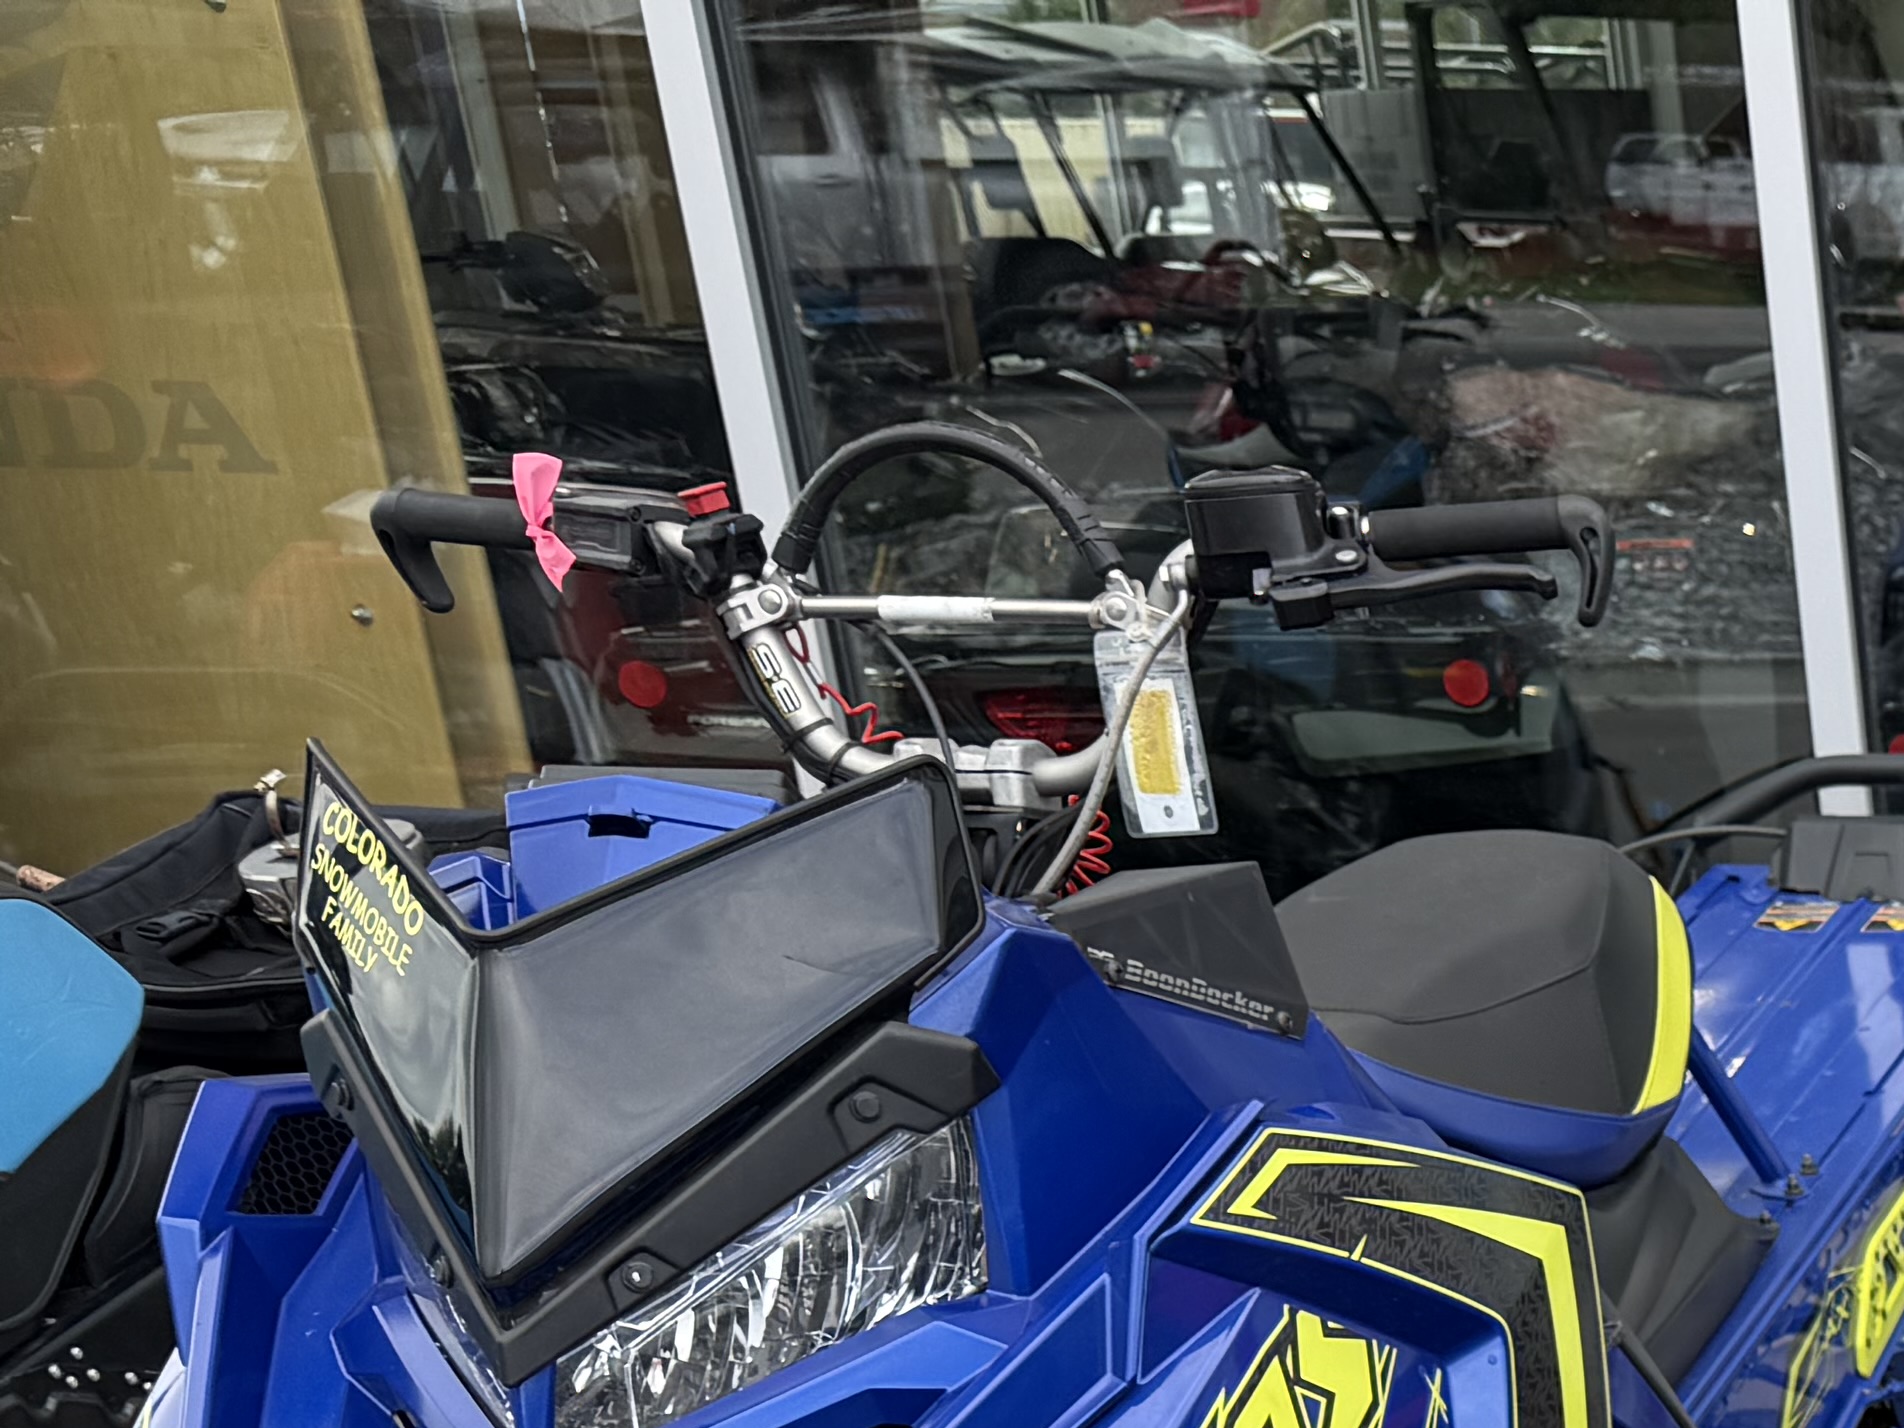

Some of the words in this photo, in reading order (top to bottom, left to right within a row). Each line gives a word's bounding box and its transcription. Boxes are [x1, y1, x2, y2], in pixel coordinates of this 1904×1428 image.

[311, 842, 415, 977] SNOWMOBILE
[322, 801, 425, 937] COLORADO
[321, 895, 379, 974] FAMILY
[1125, 957, 1275, 1021] BoonDocker
